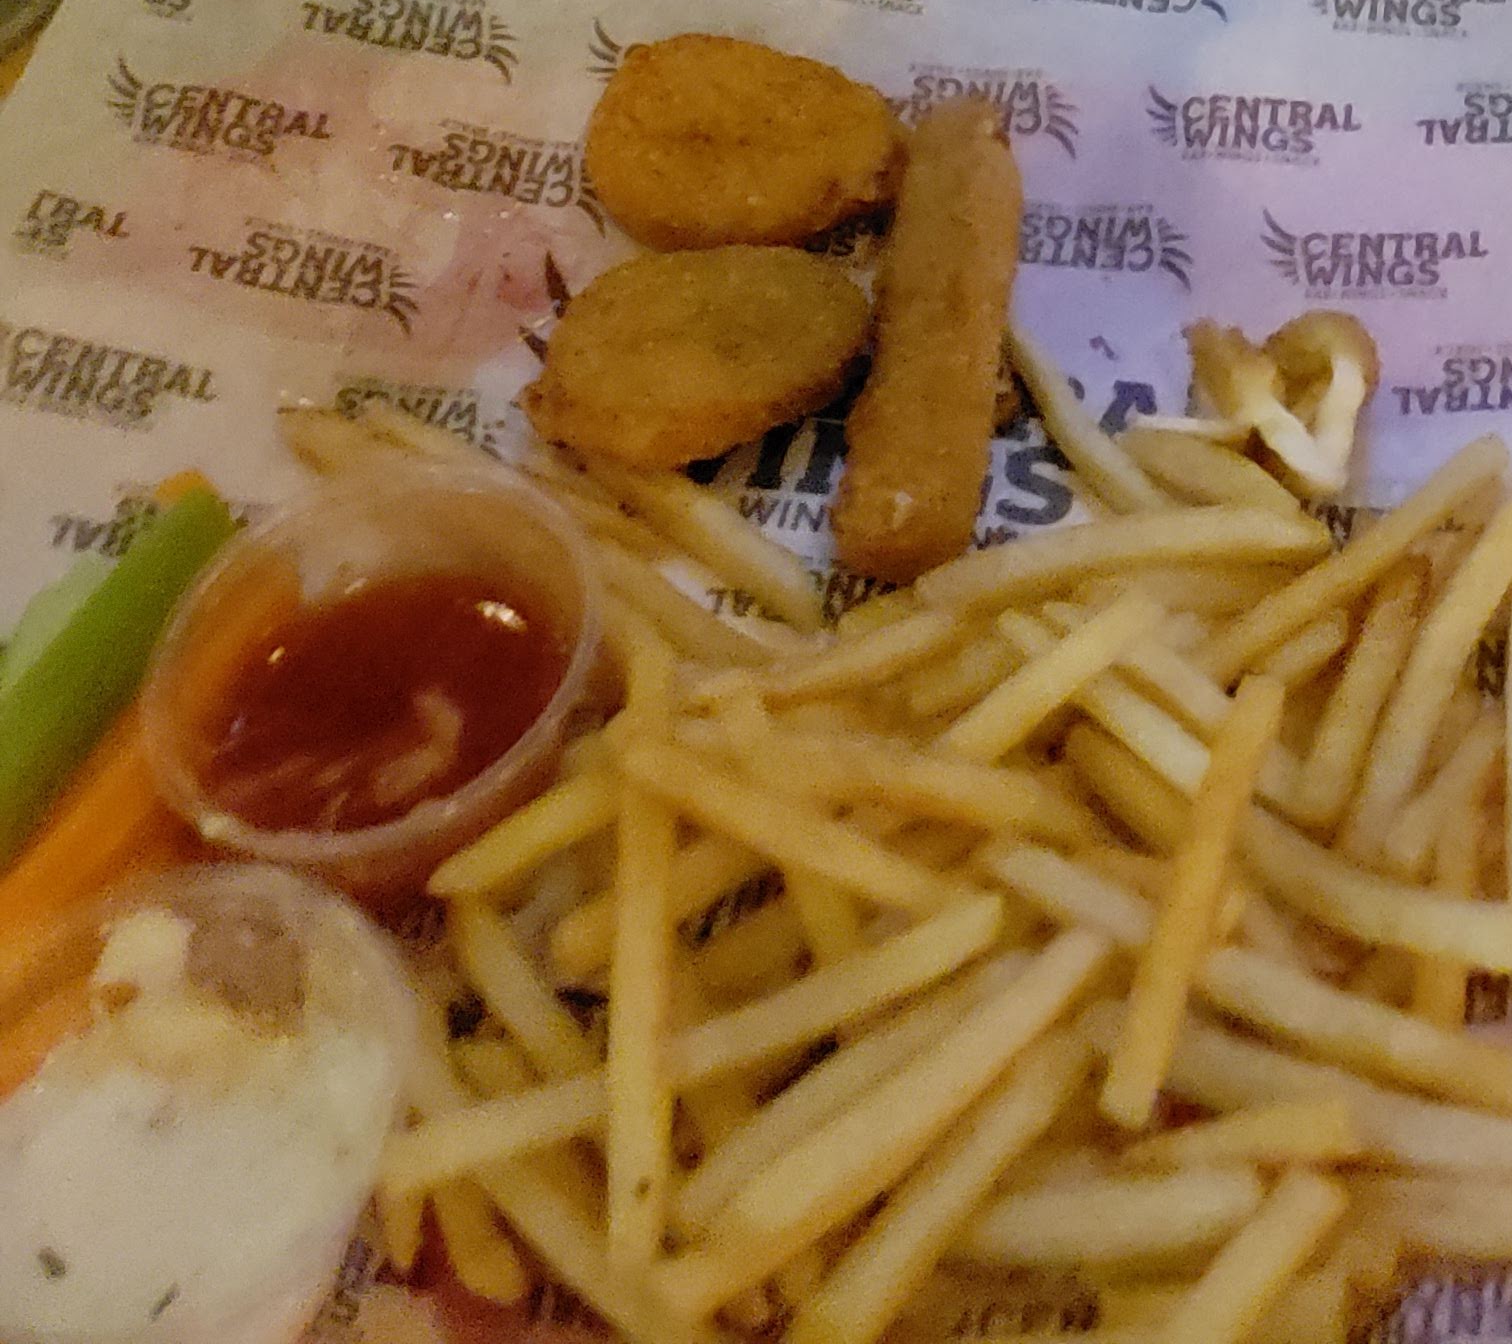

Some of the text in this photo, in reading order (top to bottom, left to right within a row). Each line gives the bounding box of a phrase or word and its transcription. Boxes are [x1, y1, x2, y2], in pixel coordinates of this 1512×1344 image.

[142, 83, 333, 139] CENTRAL
[1181, 95, 1362, 133] CENTRAL
[1183, 118, 1315, 154] WINGS
[1301, 230, 1489, 261] CENTRAL
[1304, 256, 1440, 288] WINGS
